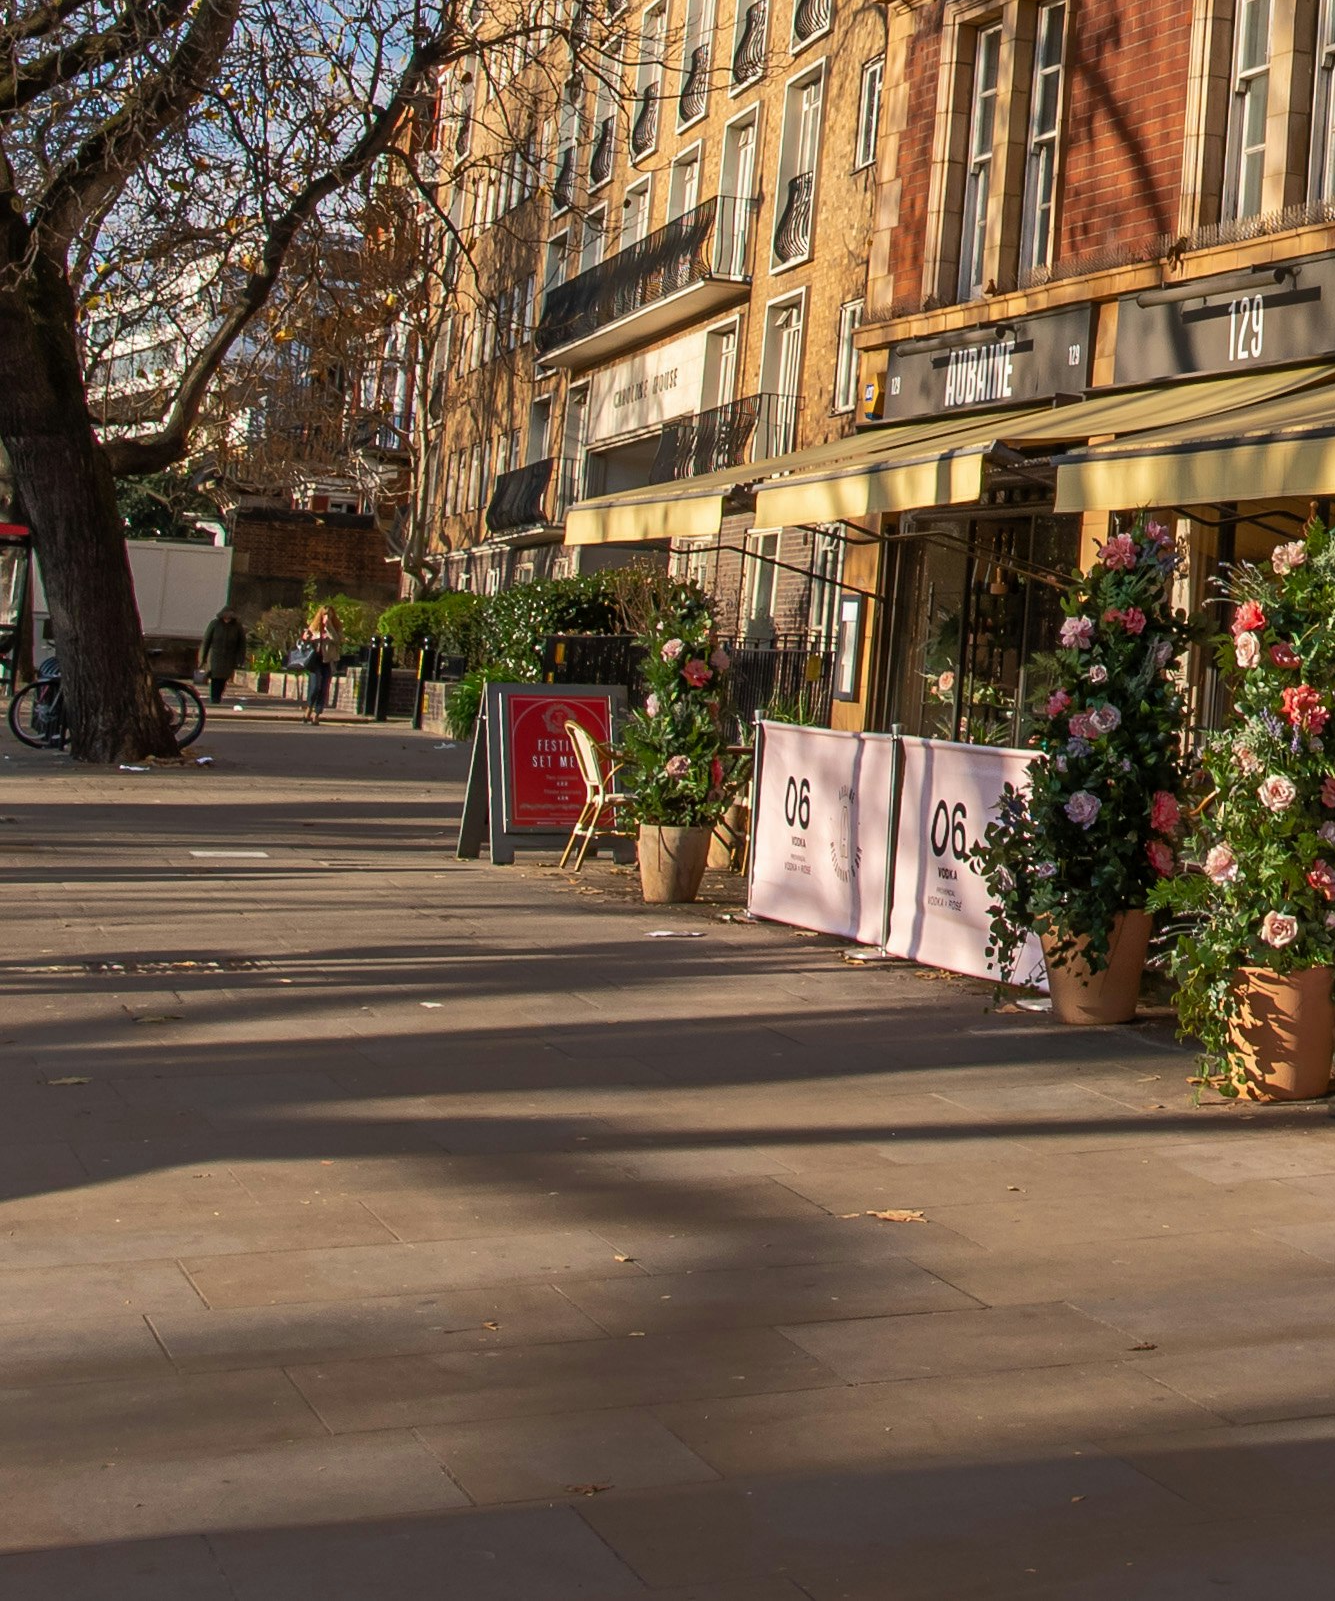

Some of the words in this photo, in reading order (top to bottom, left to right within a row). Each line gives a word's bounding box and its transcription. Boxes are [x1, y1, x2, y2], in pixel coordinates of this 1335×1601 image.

[1228, 294, 1264, 361] 129
[944, 340, 1016, 407] AUBAINE
[1068, 344, 1081, 367] 129
[532, 755, 552, 768] SET
[559, 755, 580, 768] ME
[537, 739, 574, 752] FESTI
[784, 775, 811, 830] 06
[930, 799, 967, 860] 06
[937, 866, 958, 880] VODKA
